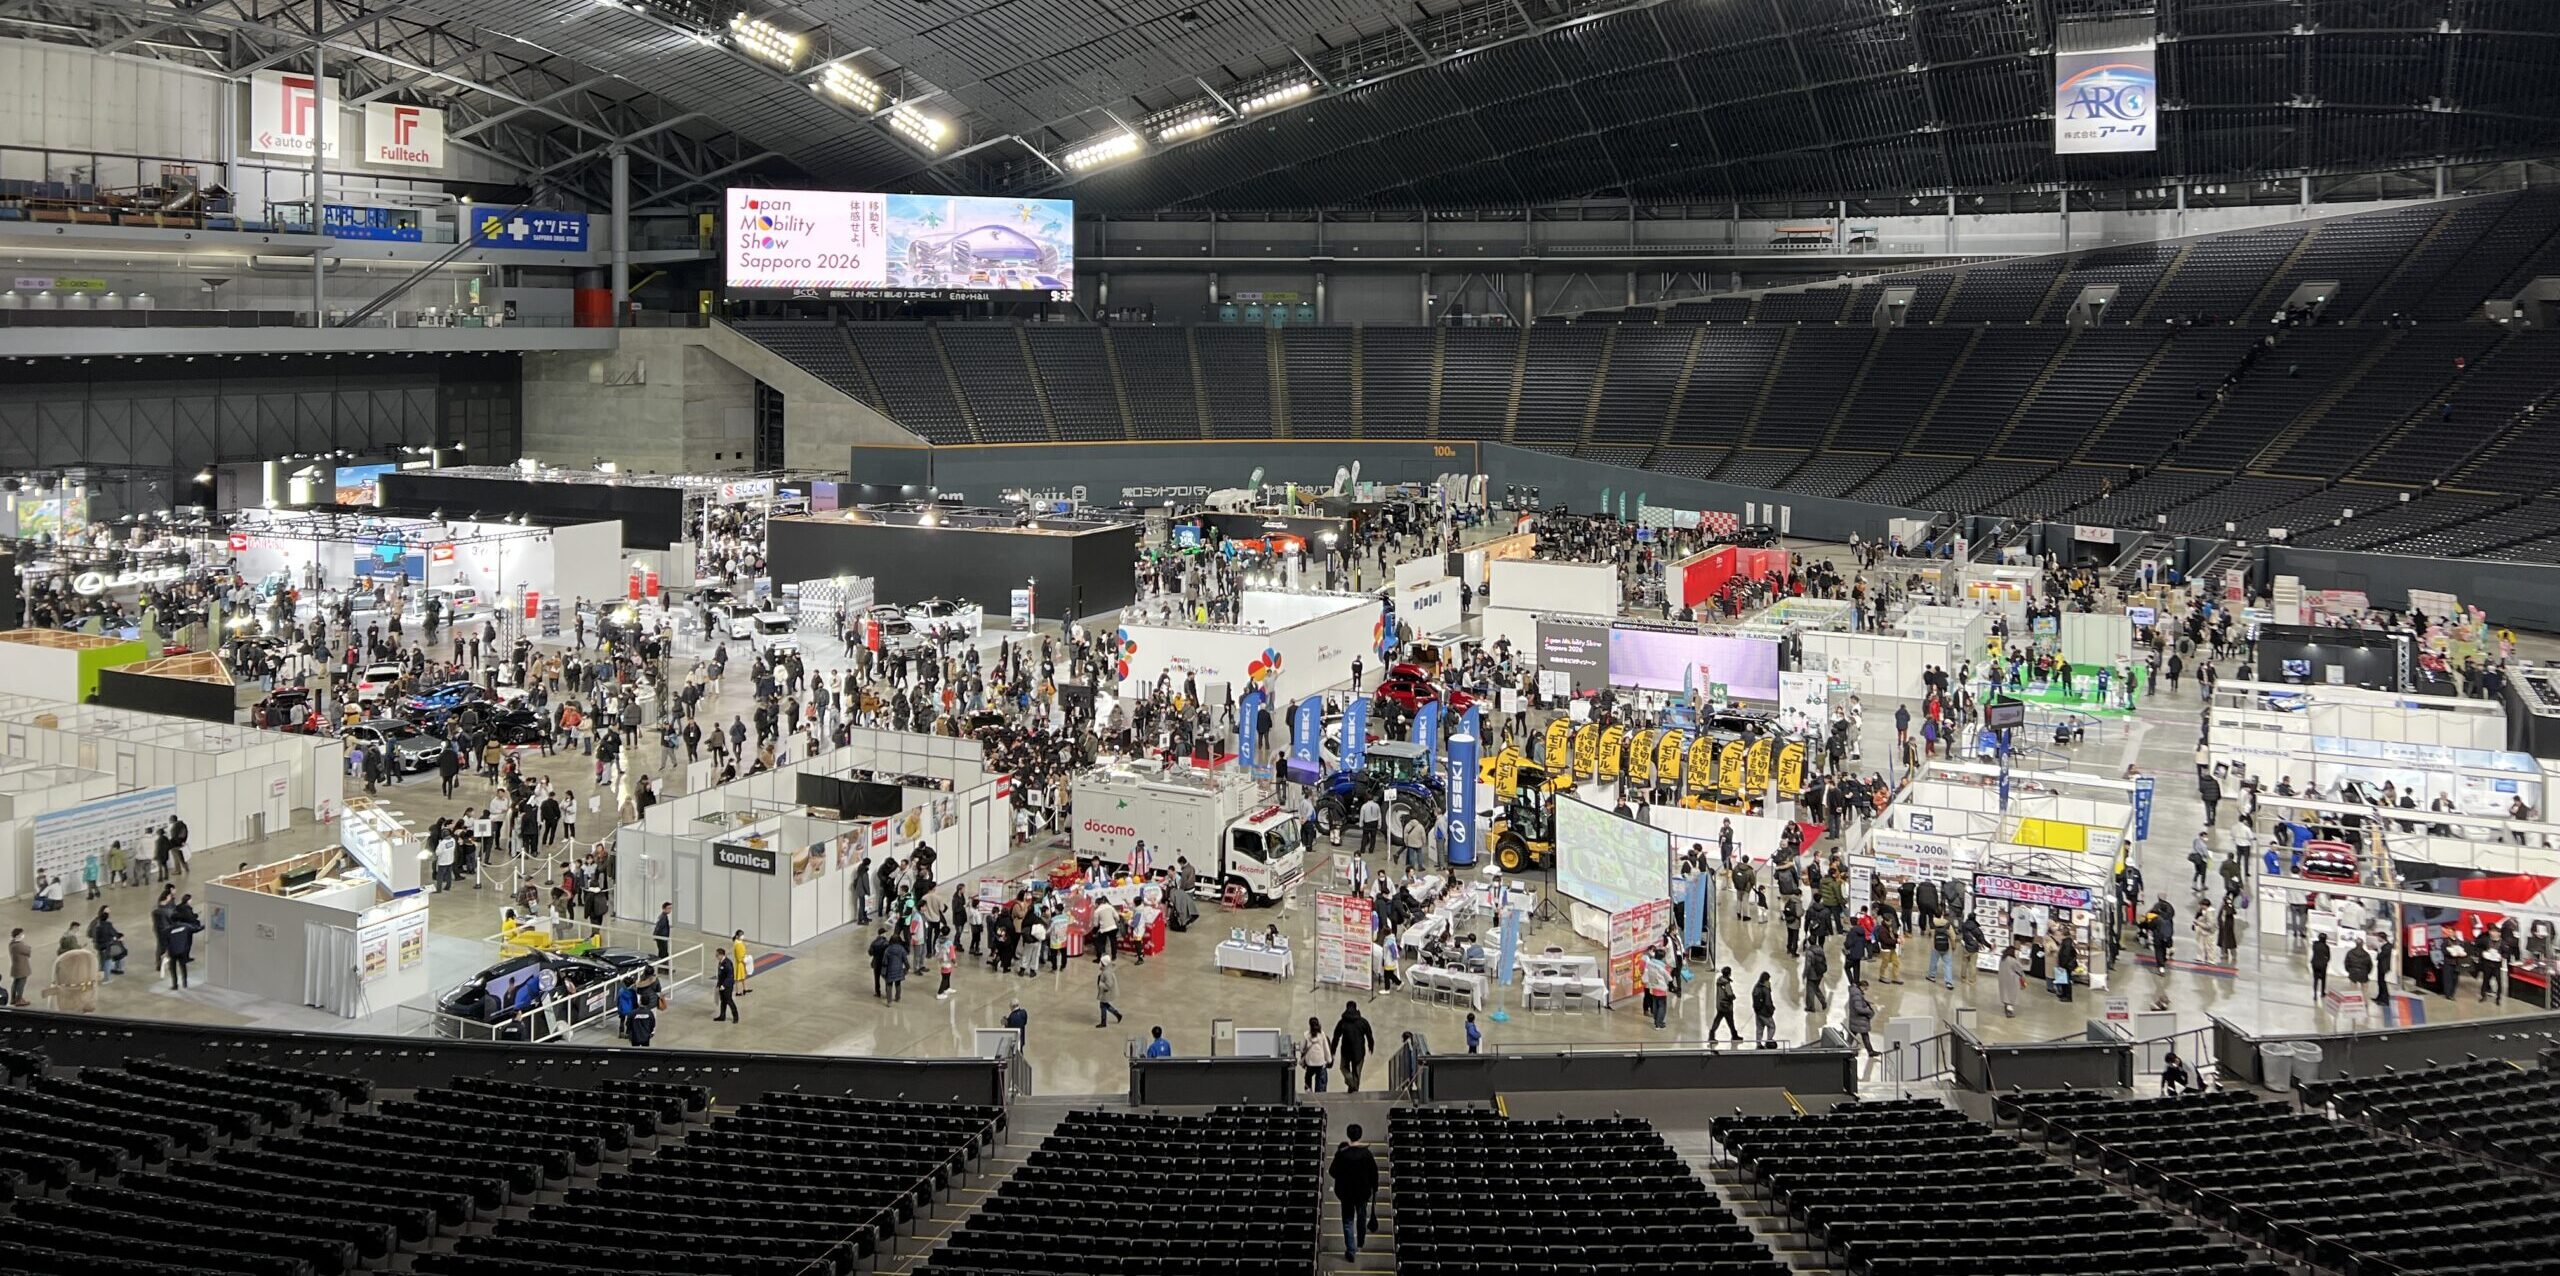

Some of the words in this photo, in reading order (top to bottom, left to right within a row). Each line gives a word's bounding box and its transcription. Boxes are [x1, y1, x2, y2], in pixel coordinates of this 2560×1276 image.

[2064, 85, 2147, 121] ARC
[275, 138, 302, 149] auto
[381, 146, 429, 163] Fulltech
[740, 195, 791, 214] Japan
[533, 219, 580, 234] サツドラ
[740, 215, 815, 236] Mobility
[740, 233, 789, 249] Show
[740, 252, 811, 272] Sapporo
[817, 254, 860, 269] 2026
[1050, 290, 1073, 301] 9:32
[2081, 527, 2108, 538] トイレ
[104, 566, 185, 587] LEXUS
[1170, 655, 1190, 664] Japan
[1301, 708, 1310, 743] ISEKI
[1348, 712, 1356, 748] ISEKI
[1452, 761, 1463, 813] ISEKI
[1084, 819, 1135, 837] docomo
[719, 849, 770, 869] tomica
[1238, 865, 1265, 874] docomo
